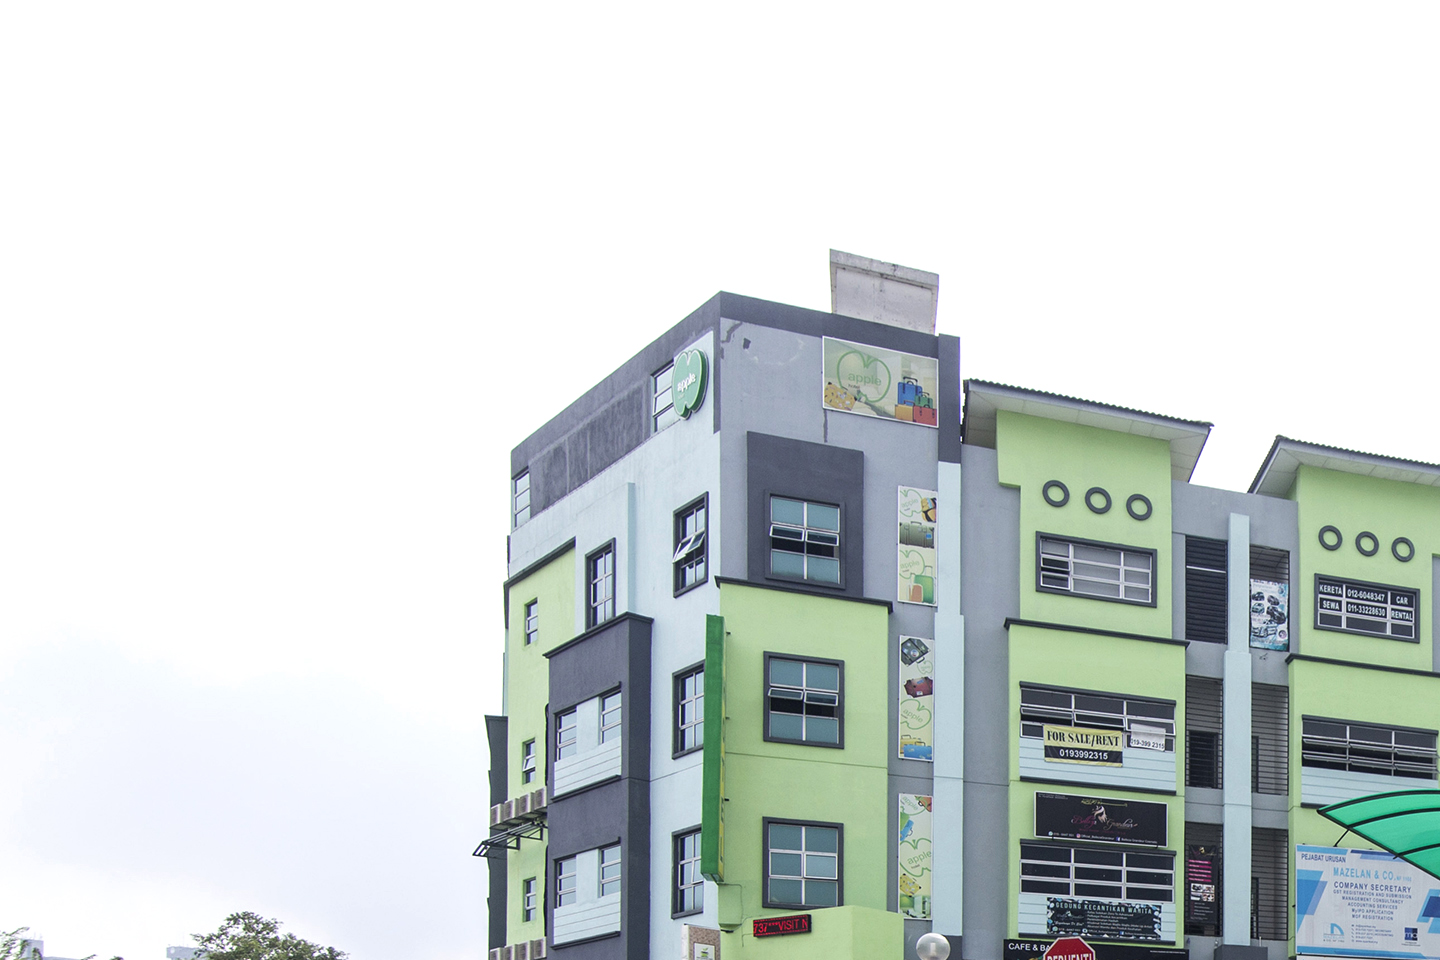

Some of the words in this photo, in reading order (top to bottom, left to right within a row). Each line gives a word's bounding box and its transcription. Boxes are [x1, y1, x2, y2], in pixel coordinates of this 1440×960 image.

[847, 372, 883, 387] apple
[1319, 584, 1343, 595] KERETA
[1395, 595, 1409, 605] CAR
[1322, 600, 1340, 610] SEWA
[1391, 610, 1413, 621] RENTAL
[1047, 730, 1066, 743] FOR
[1067, 732, 1120, 748] SALE/RENT
[1059, 748, 1109, 761] 0193992315
[907, 850, 932, 865] apple
[1301, 853, 1324, 861] PEJABAT
[1325, 855, 1347, 863] URUSAN
[1333, 867, 1371, 879] MAZELAN
[1374, 870, 1380, 880] &
[1333, 881, 1368, 891] COMPANY
[1371, 884, 1412, 893] SECRETARY
[1055, 902, 1082, 910] GEDUNG
[1084, 904, 1125, 913] KECANTIKAN
[1127, 907, 1153, 915] WANITA
[1008, 943, 1031, 951] CAFE
